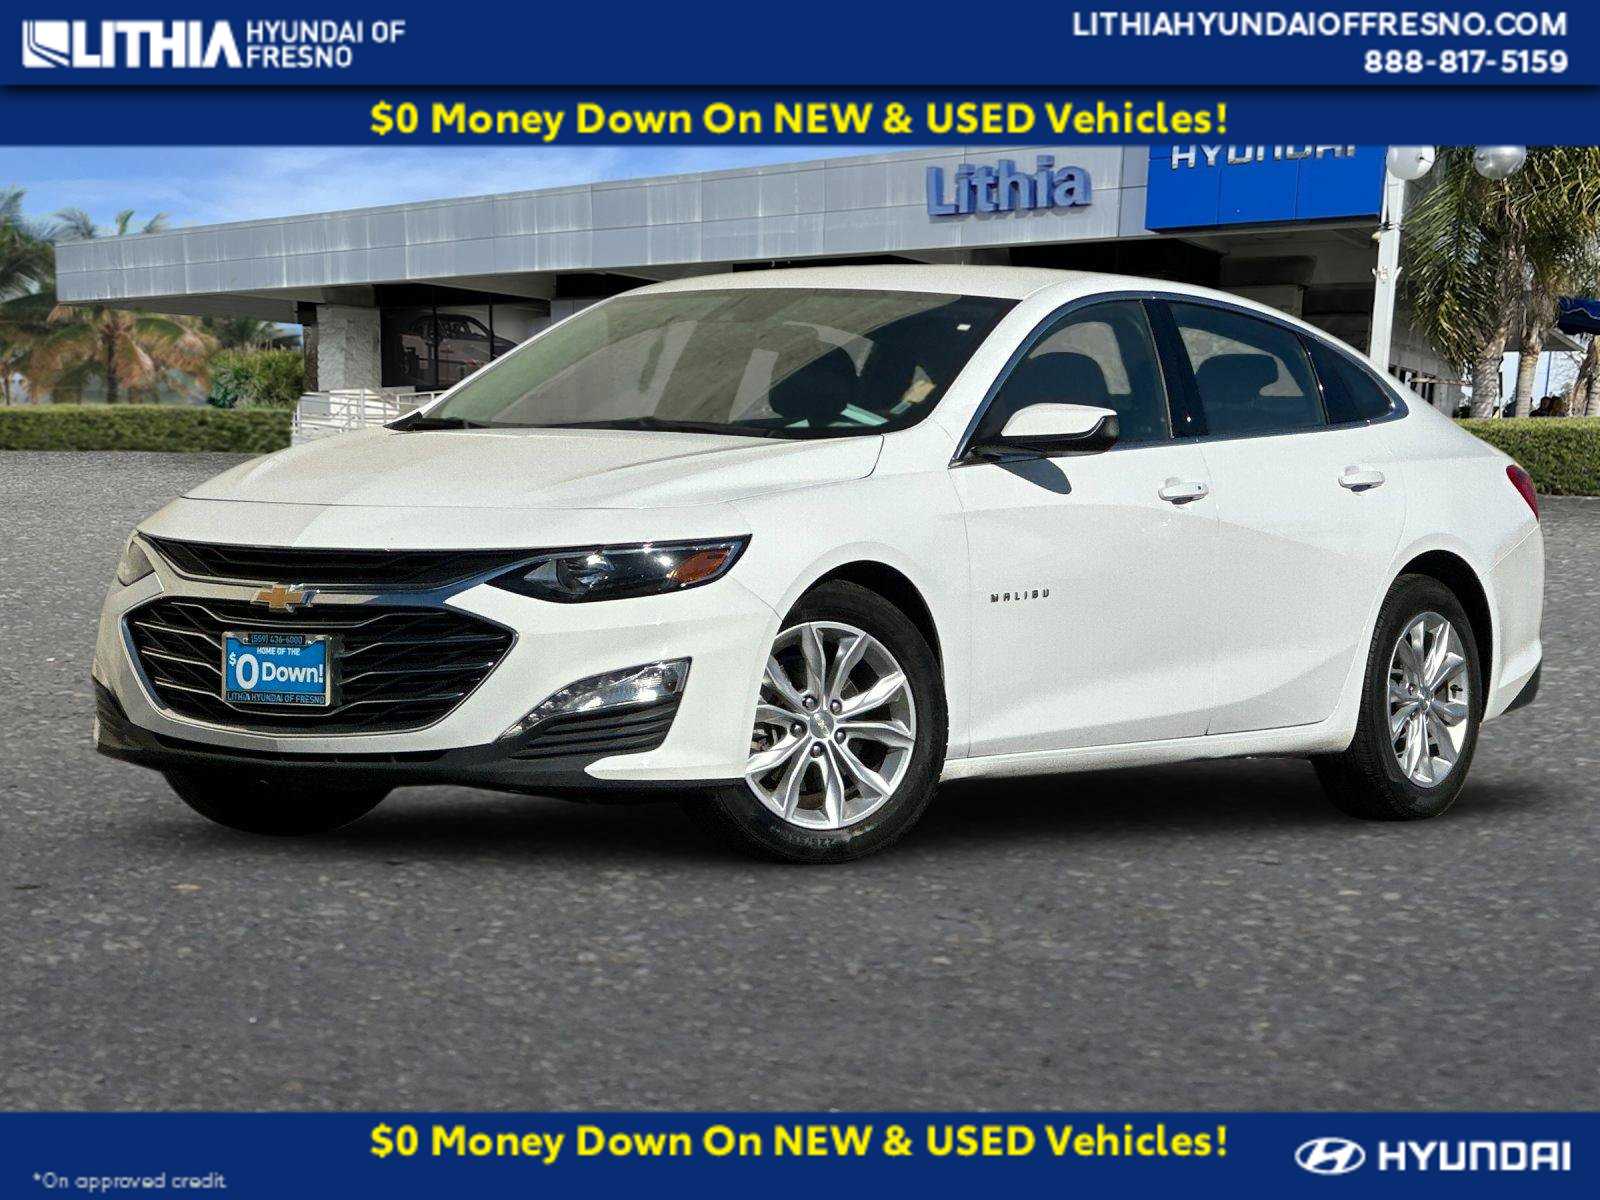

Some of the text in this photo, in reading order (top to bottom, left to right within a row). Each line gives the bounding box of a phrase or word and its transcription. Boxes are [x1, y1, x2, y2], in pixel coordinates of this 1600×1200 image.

[927, 155, 1092, 216] Lithia
[990, 588, 1050, 603] MALIBU
[256, 646, 301, 656] HOME OF THE
[261, 661, 324, 684] Down!
